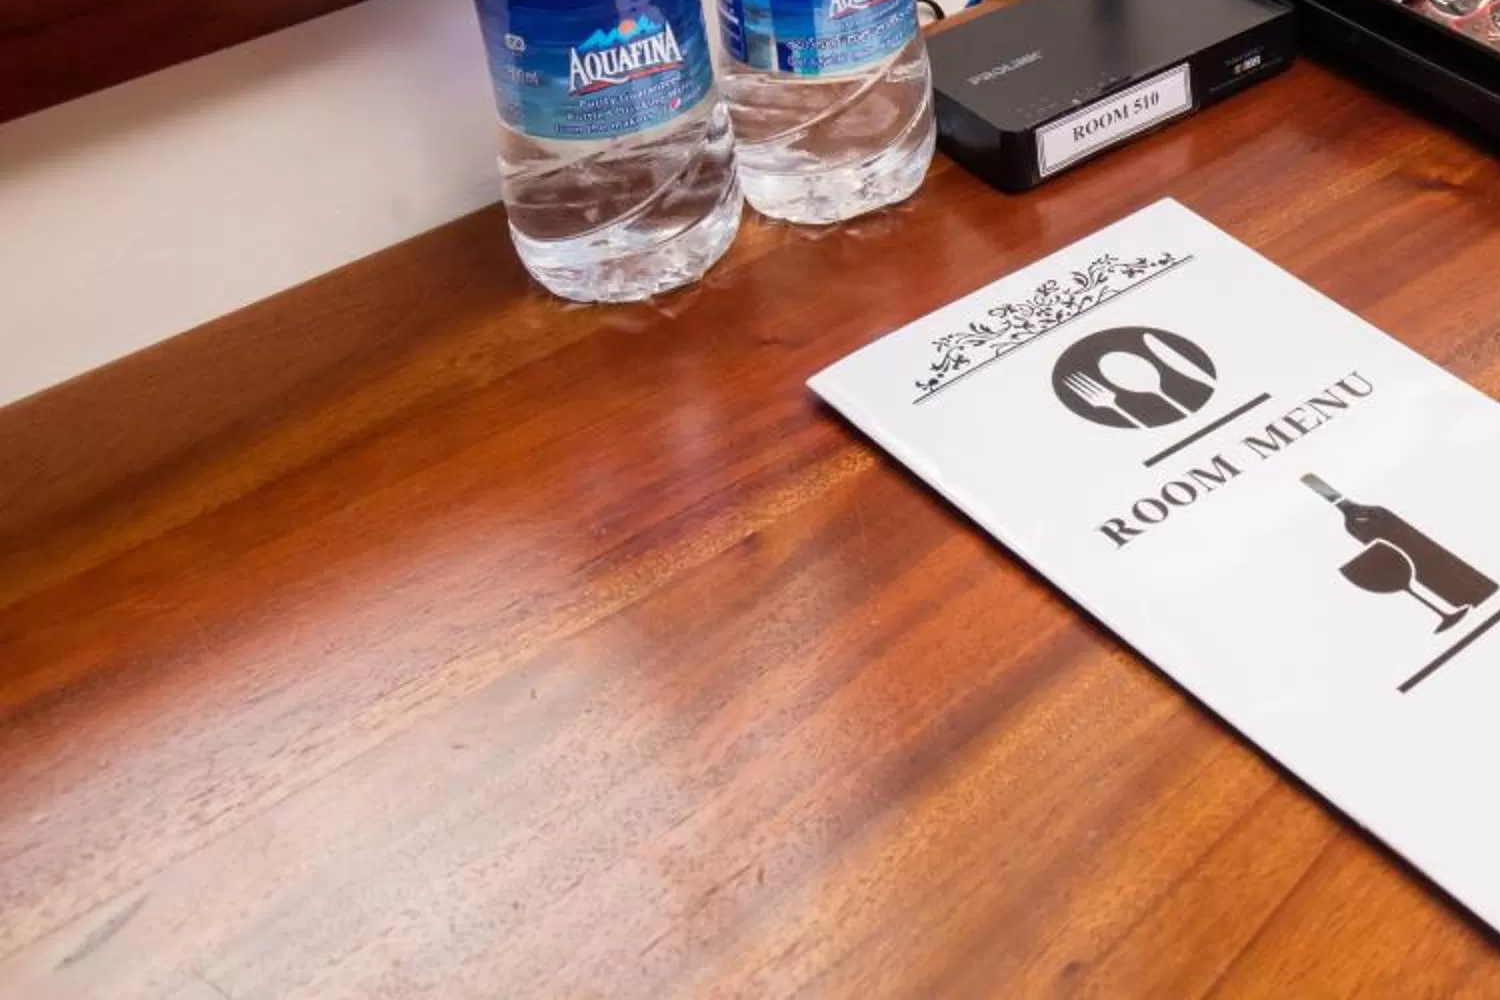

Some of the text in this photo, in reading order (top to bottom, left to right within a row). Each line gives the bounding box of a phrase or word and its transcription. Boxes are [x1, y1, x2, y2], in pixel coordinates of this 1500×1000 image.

[569, 21, 683, 91] AQUAFINA
[1072, 90, 1160, 142] ROOM 510
[1097, 370, 1374, 550] ROOM MENU
